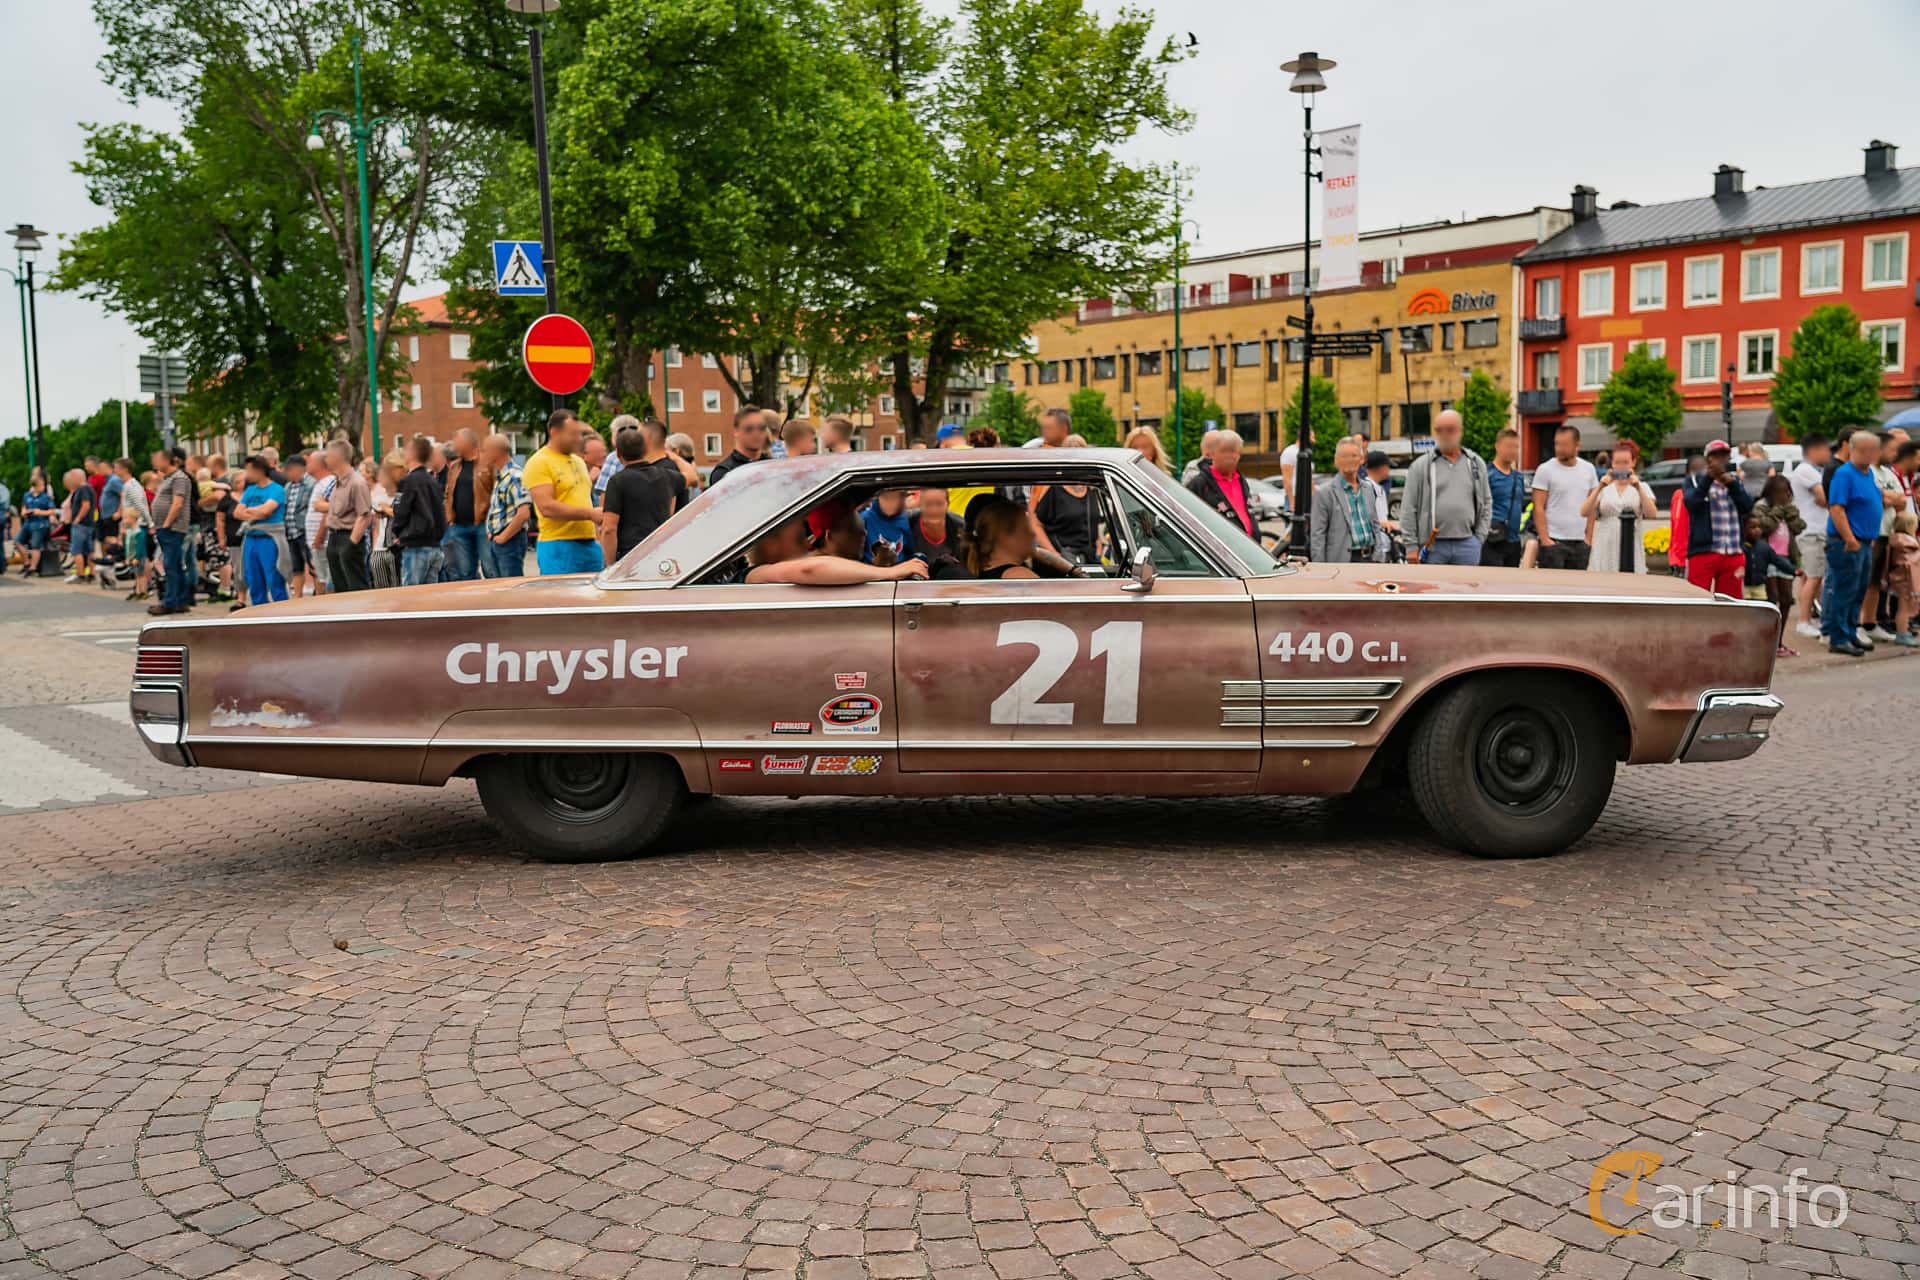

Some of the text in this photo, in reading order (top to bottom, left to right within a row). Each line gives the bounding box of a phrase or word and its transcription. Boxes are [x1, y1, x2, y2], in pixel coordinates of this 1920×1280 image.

[1451, 290, 1496, 312] Bixia
[1268, 631, 1354, 664] 440
[446, 639, 689, 695] Chrysler
[991, 619, 1143, 725] 21
[764, 756, 804, 769] SUMMIT
